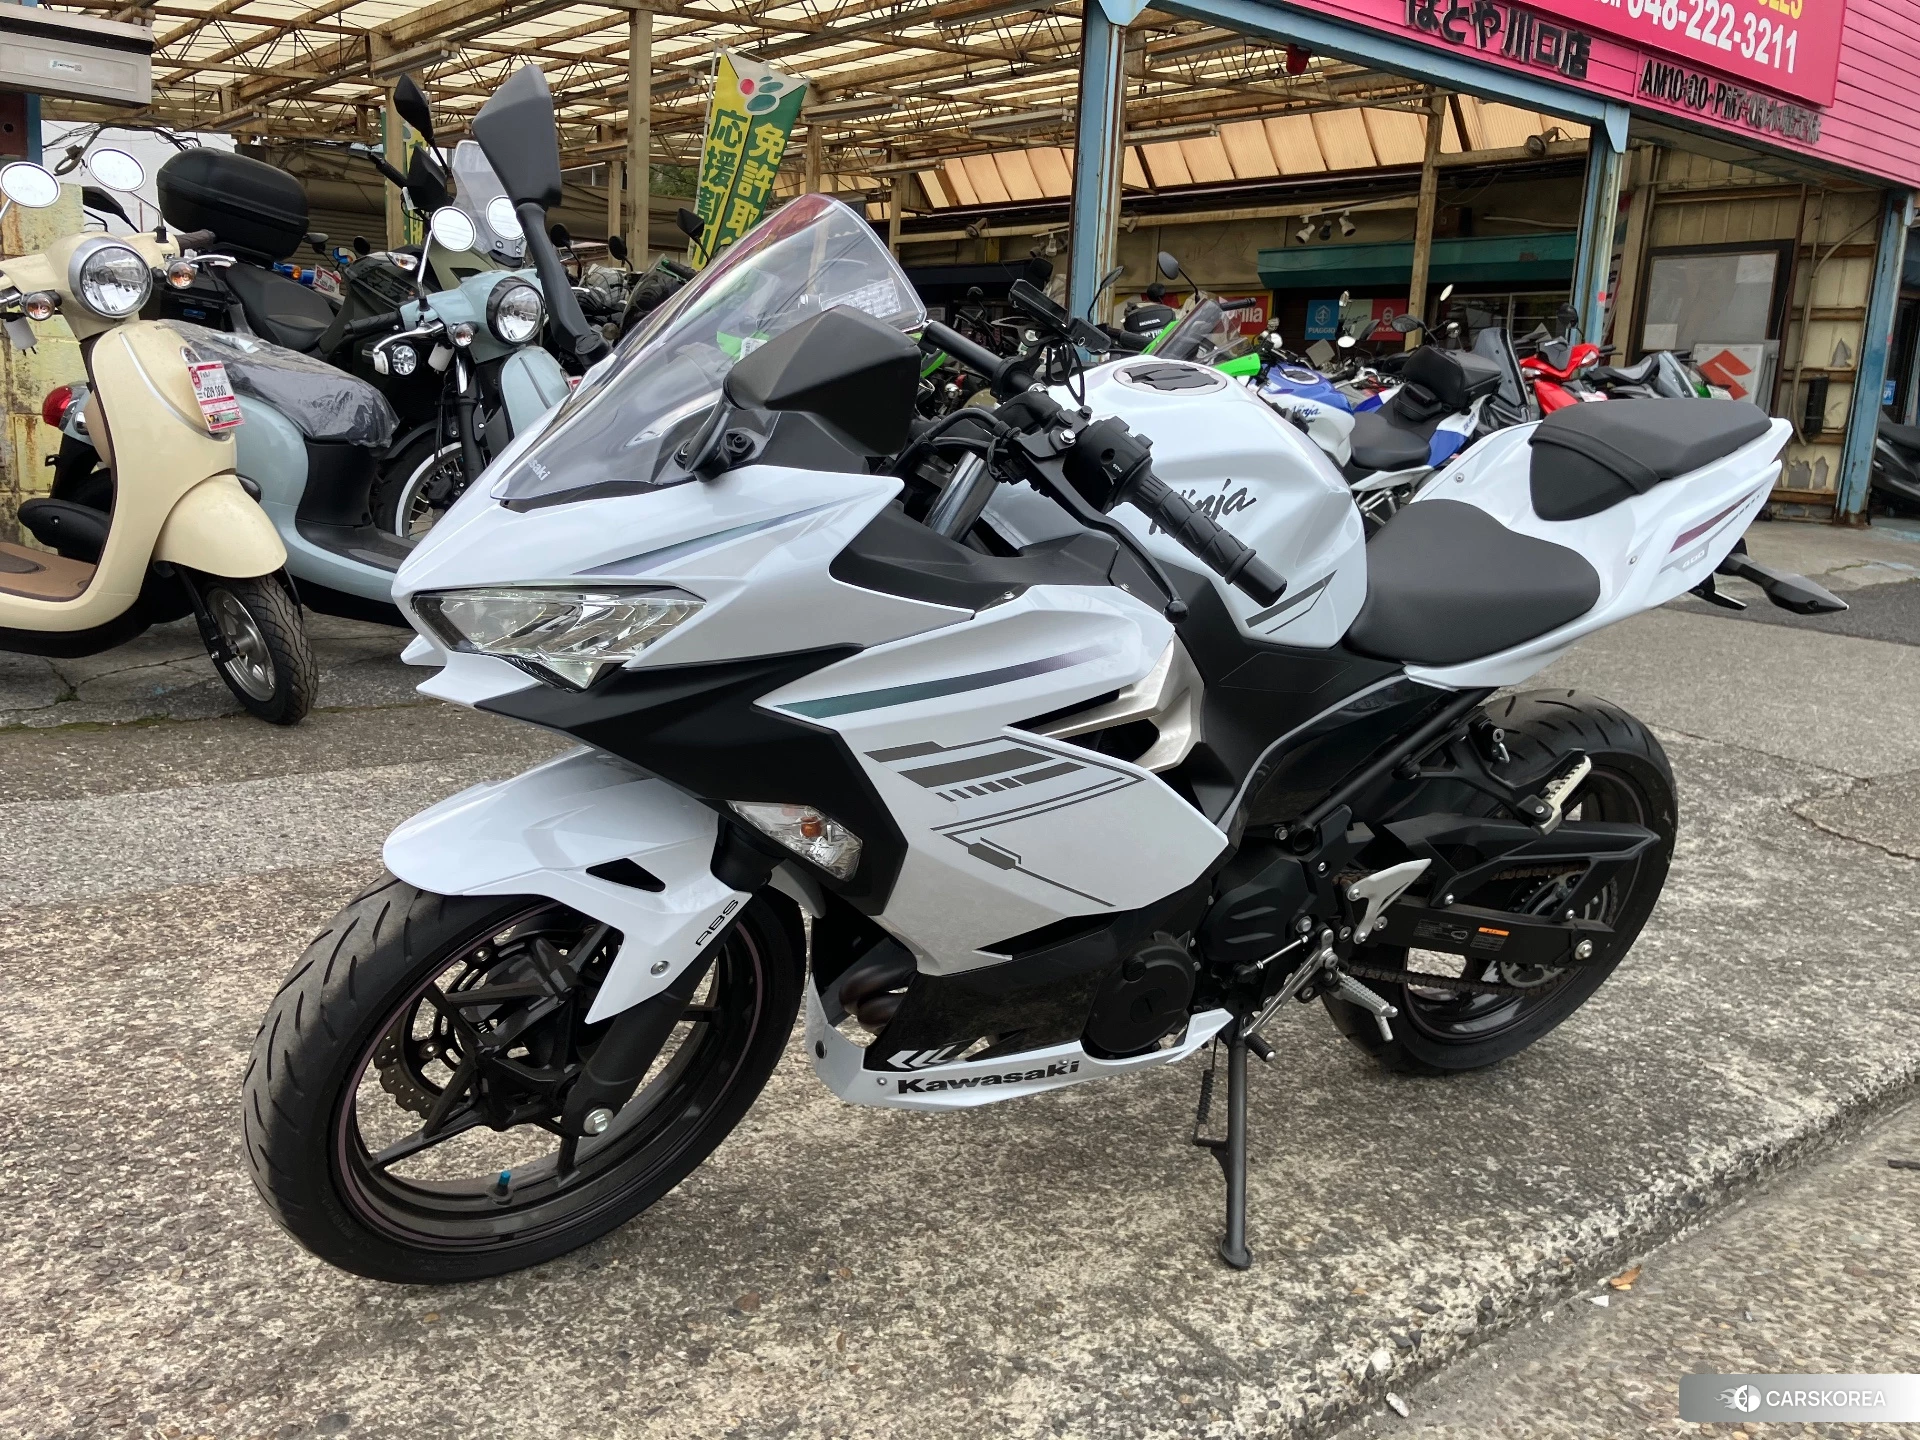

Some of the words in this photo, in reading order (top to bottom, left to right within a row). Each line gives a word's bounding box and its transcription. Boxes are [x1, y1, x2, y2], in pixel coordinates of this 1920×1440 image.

[719, 122, 786, 246] 免許取
[1681, 550, 1705, 569] 400
[695, 899, 739, 946] ABS
[898, 1060, 1080, 1094] Kawasaki
